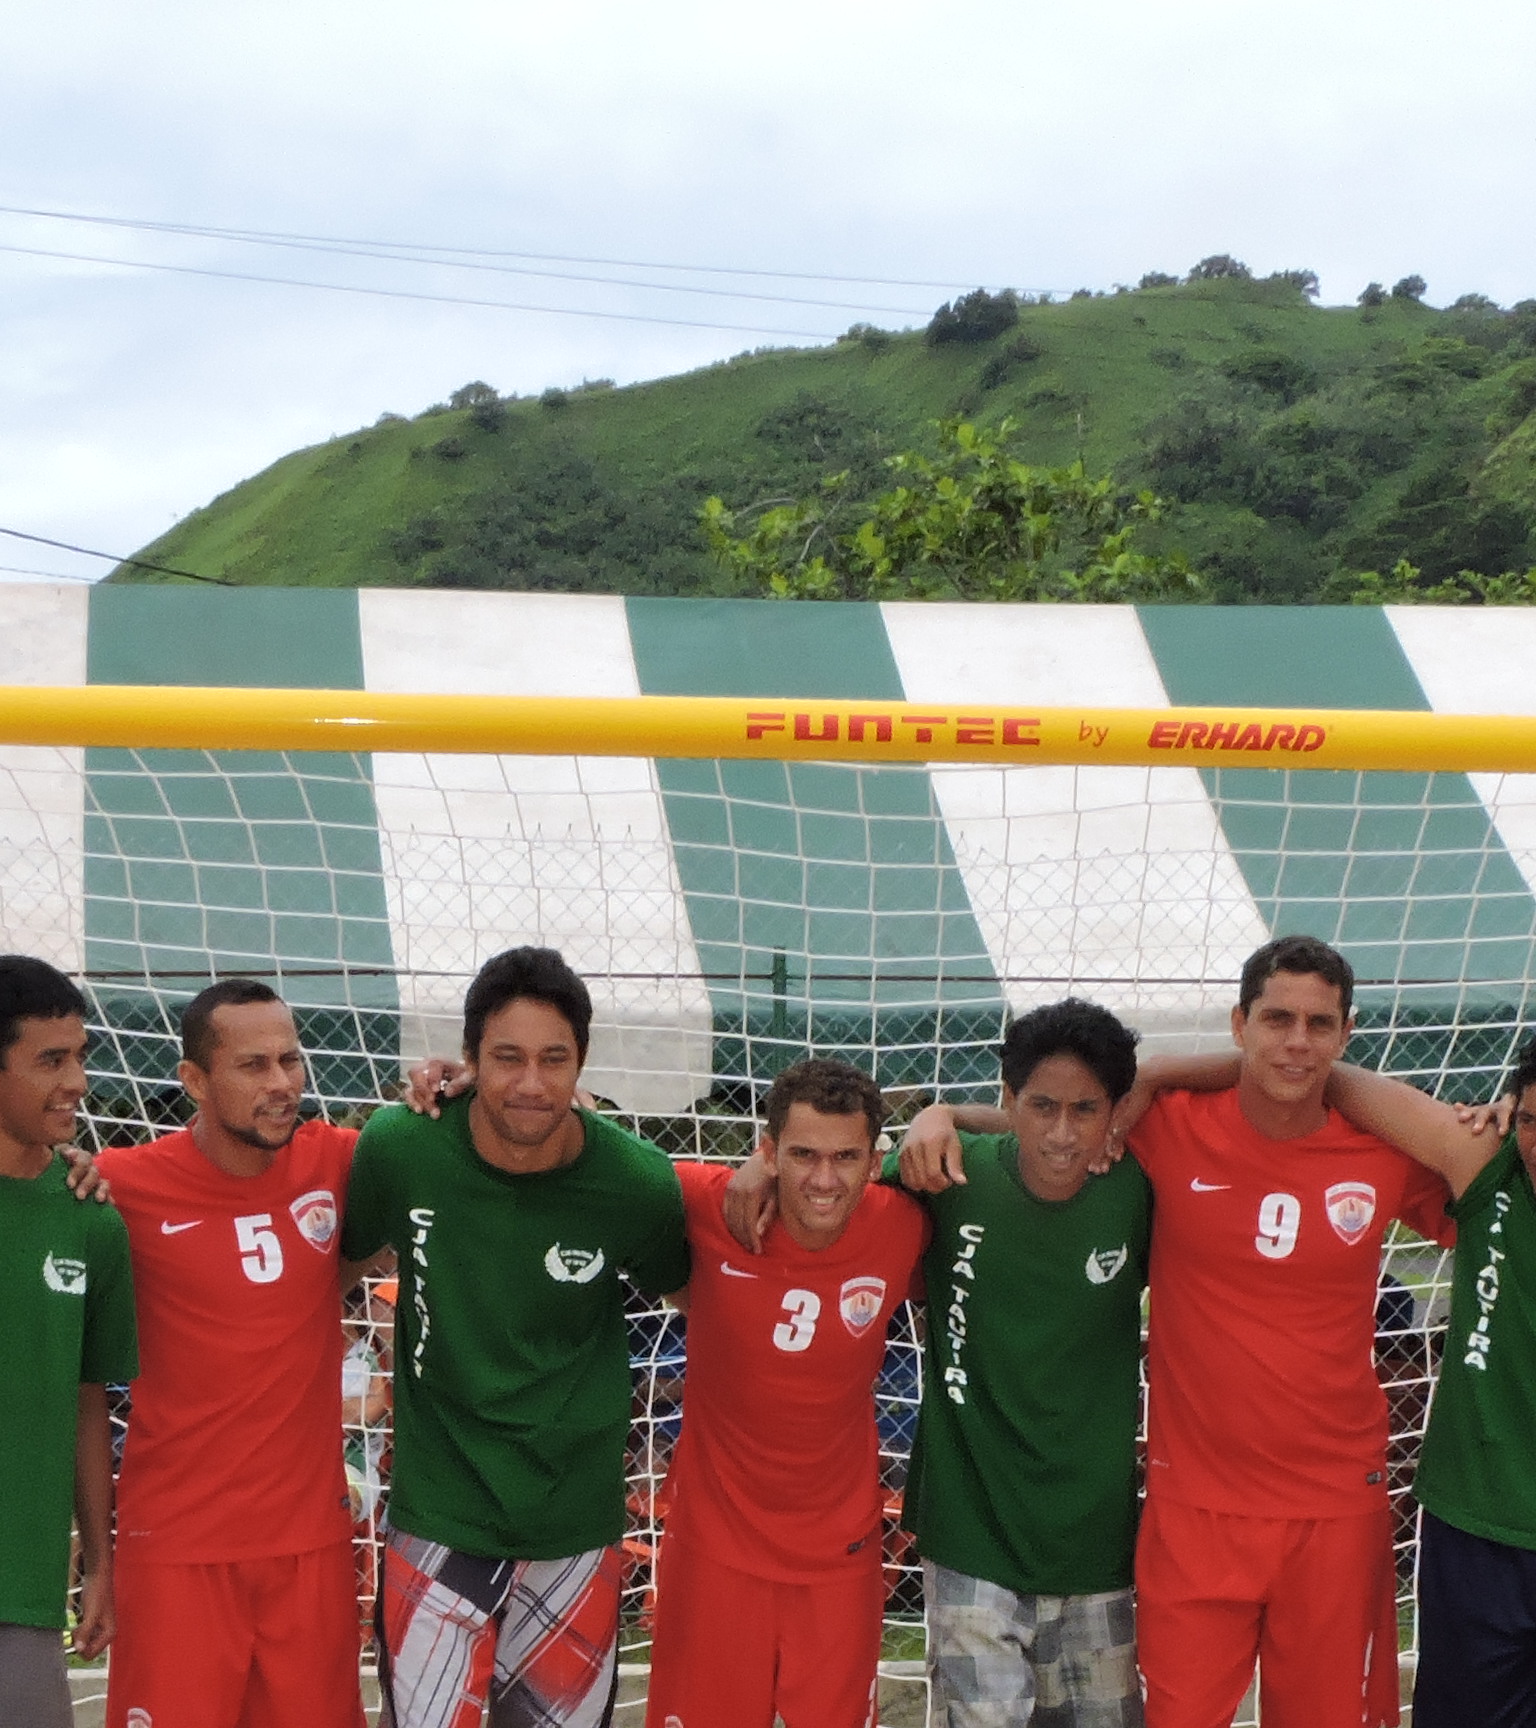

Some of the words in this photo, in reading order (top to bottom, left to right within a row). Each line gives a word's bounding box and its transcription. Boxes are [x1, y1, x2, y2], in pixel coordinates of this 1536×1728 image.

[746, 712, 1042, 746] FUNTEC
[1077, 719, 1110, 748] by
[1147, 720, 1327, 752] ERHARD
[233, 1213, 284, 1284] 5
[951, 1223, 986, 1281] CJA
[1254, 1192, 1302, 1260] 9
[772, 1288, 822, 1352] 3
[1463, 1245, 1506, 1371] TAUTIRA
[944, 1284, 971, 1405] TAUTIRA
